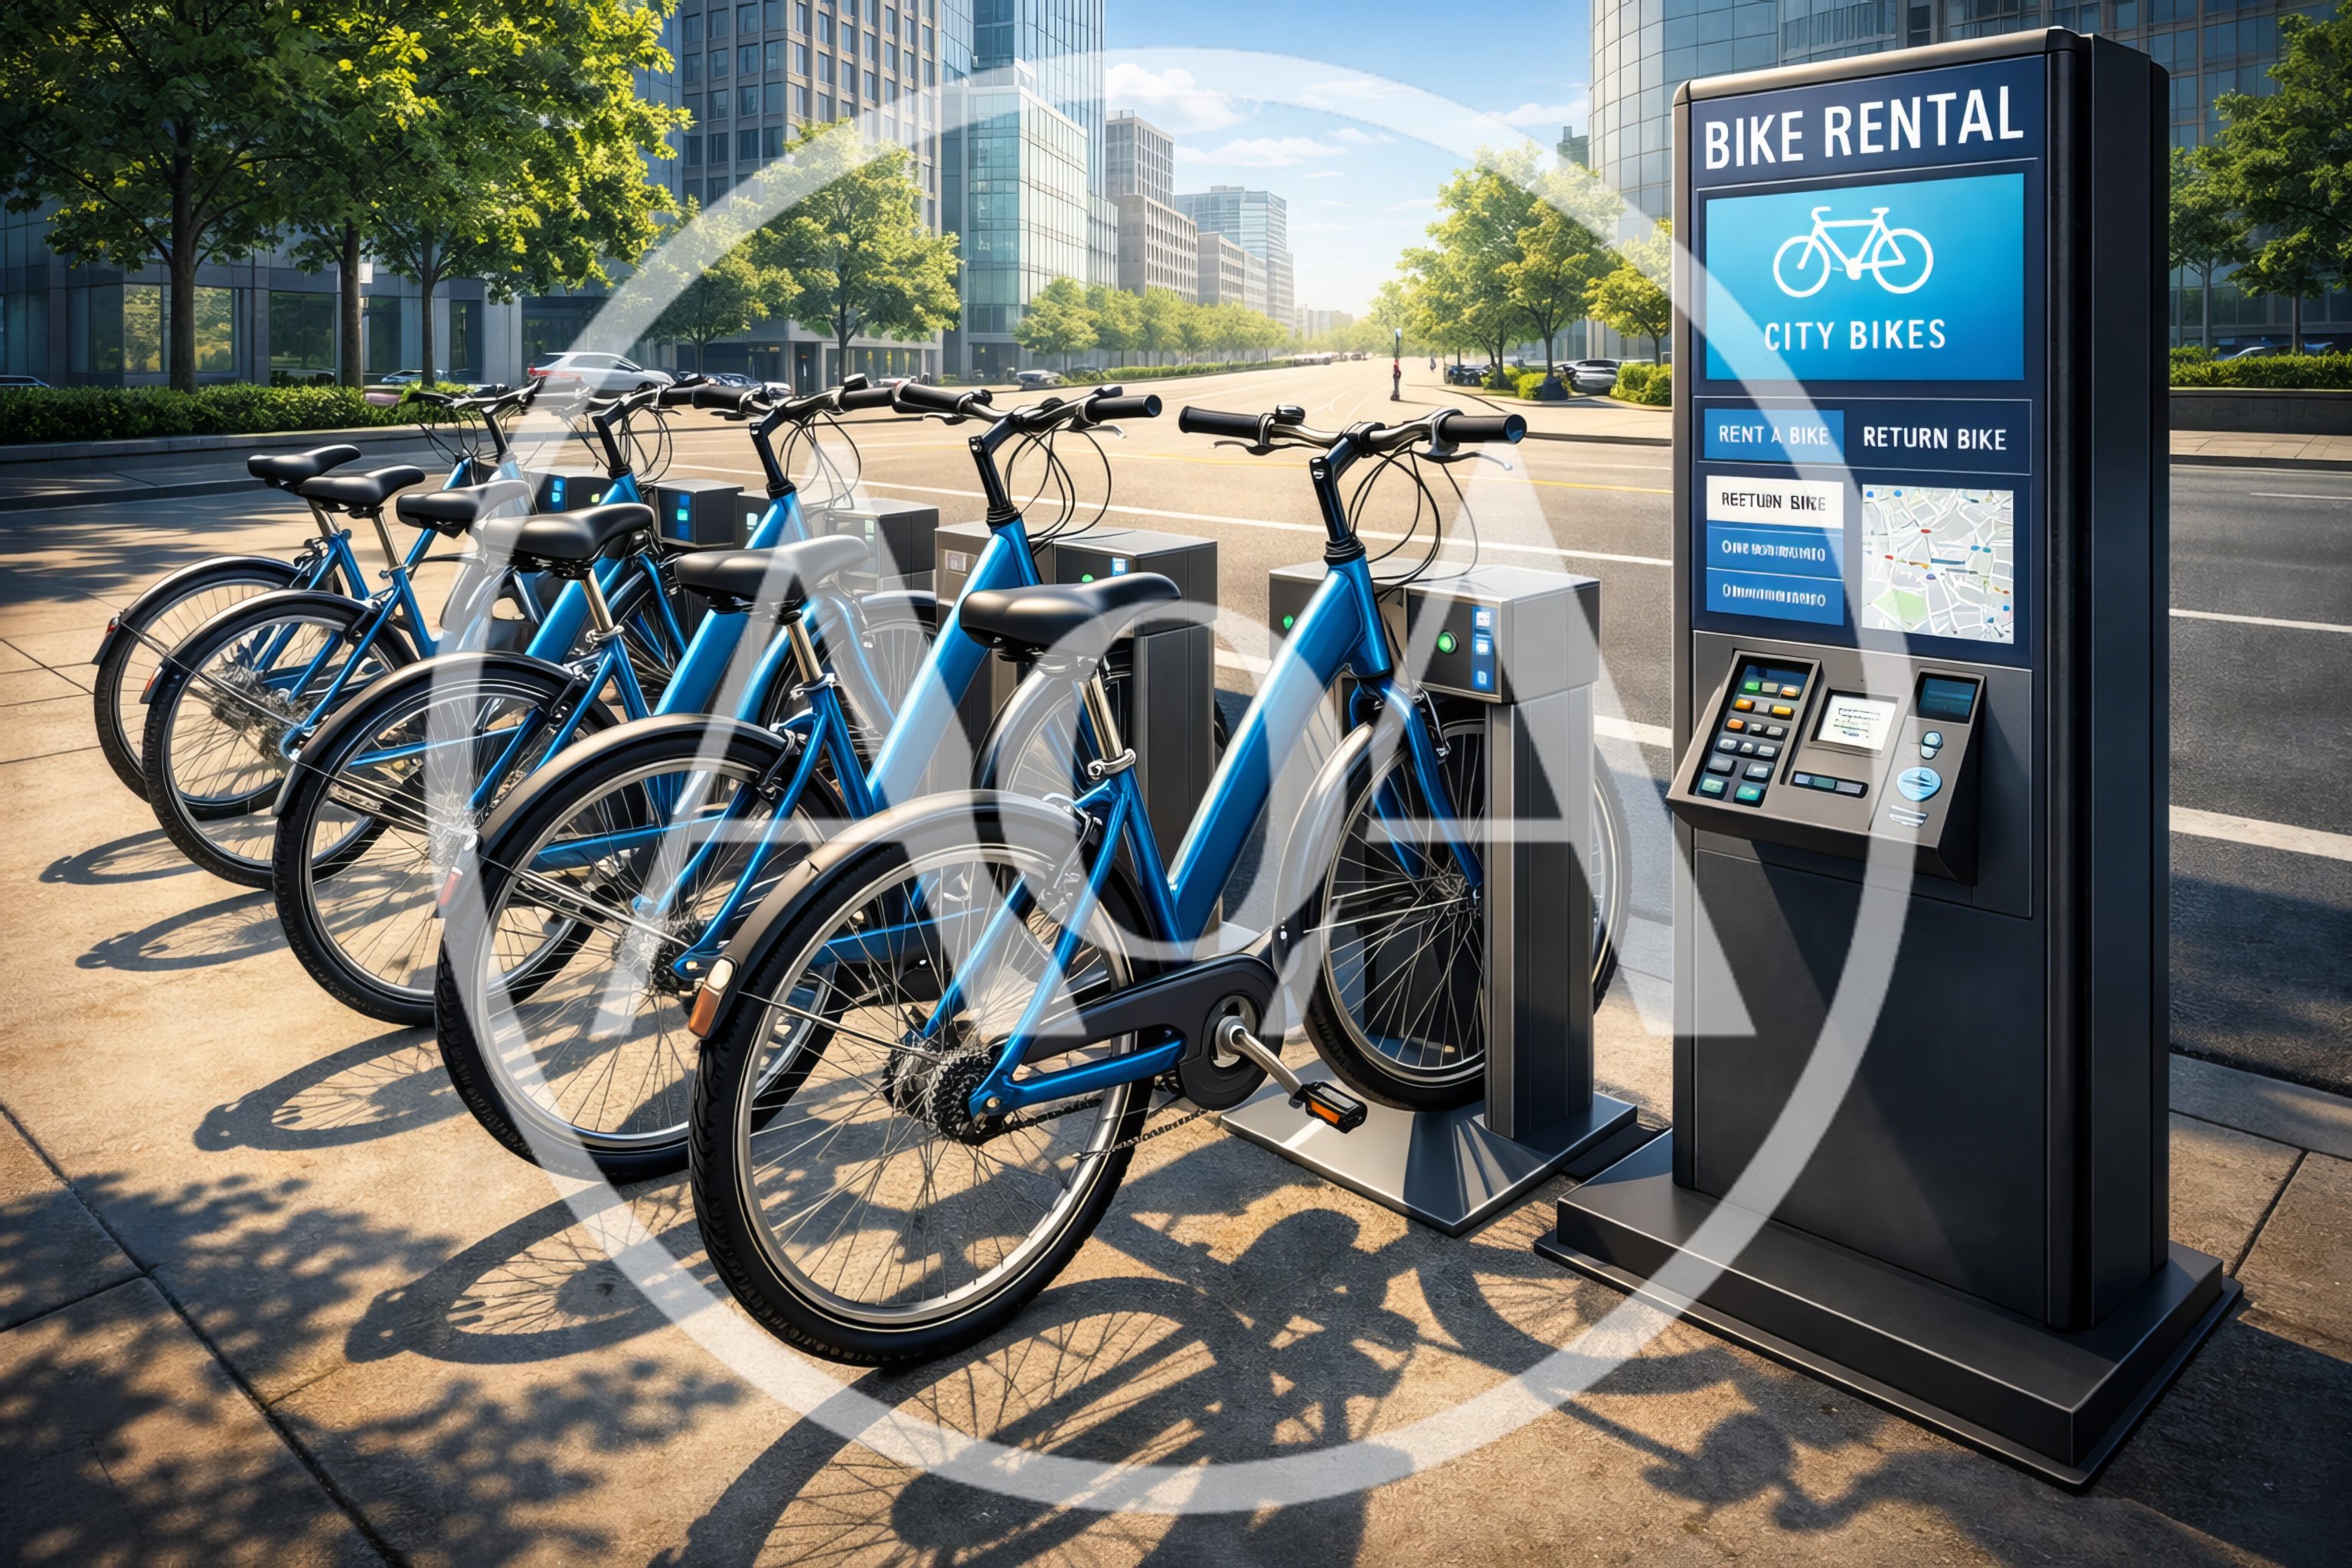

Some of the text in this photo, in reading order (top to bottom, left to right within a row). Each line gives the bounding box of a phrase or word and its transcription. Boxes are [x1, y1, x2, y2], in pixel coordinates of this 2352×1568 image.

[1705, 86, 2024, 170] BIKE RENTAL
[1764, 318, 1945, 353] CITY BIKES
[1719, 426, 1830, 446] RENT A BIKE
[1864, 426, 2007, 451] RETURN BIKE
